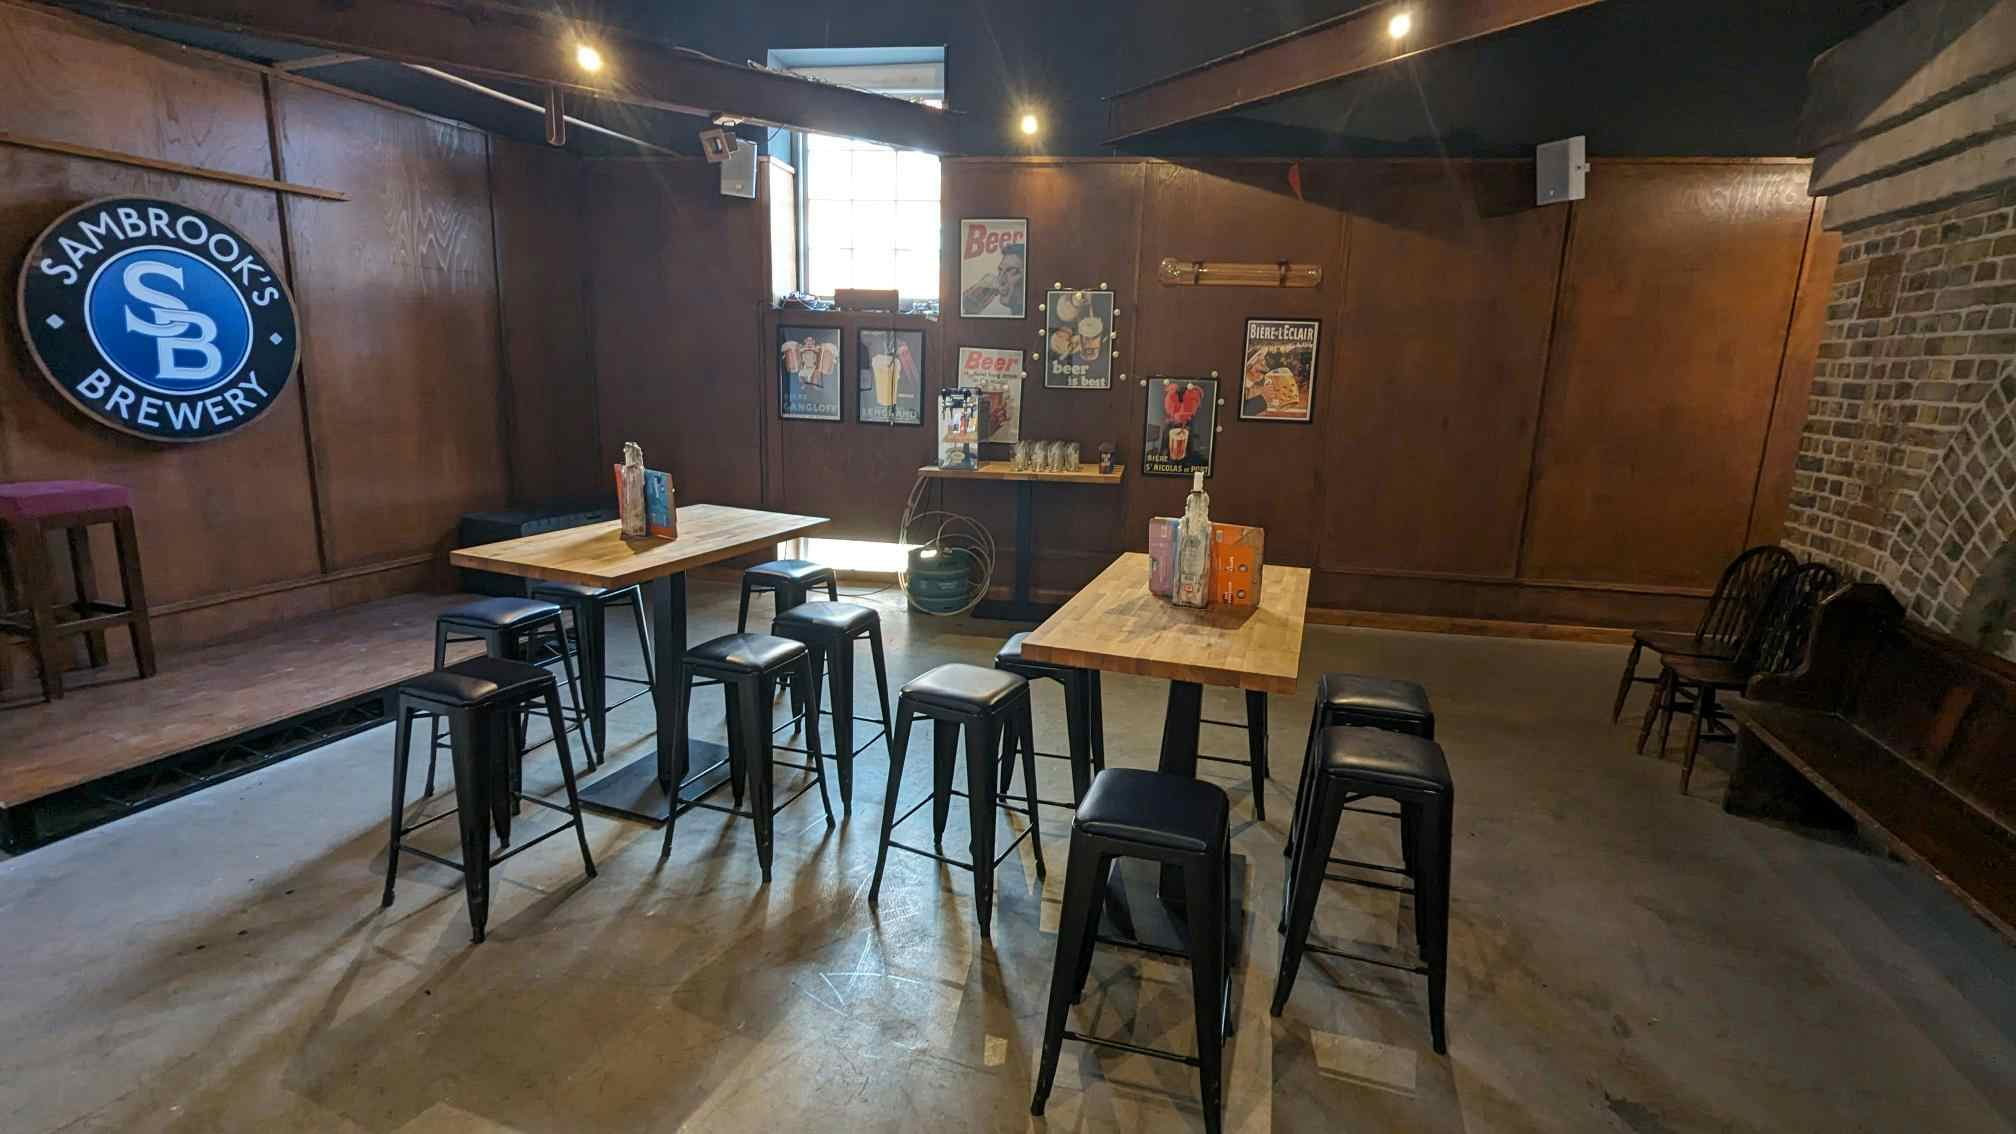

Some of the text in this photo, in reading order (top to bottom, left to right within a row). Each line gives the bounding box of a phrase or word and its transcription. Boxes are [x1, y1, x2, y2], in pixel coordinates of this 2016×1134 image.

[964, 224, 1024, 260] Beer
[40, 207, 279, 307] SAMBROOK'S
[965, 351, 1018, 372] Beer
[1052, 360, 1089, 375] beer
[1081, 375, 1107, 387] best
[75, 369, 269, 430] BREWERY
[1153, 463, 1183, 473] NICOLAS
